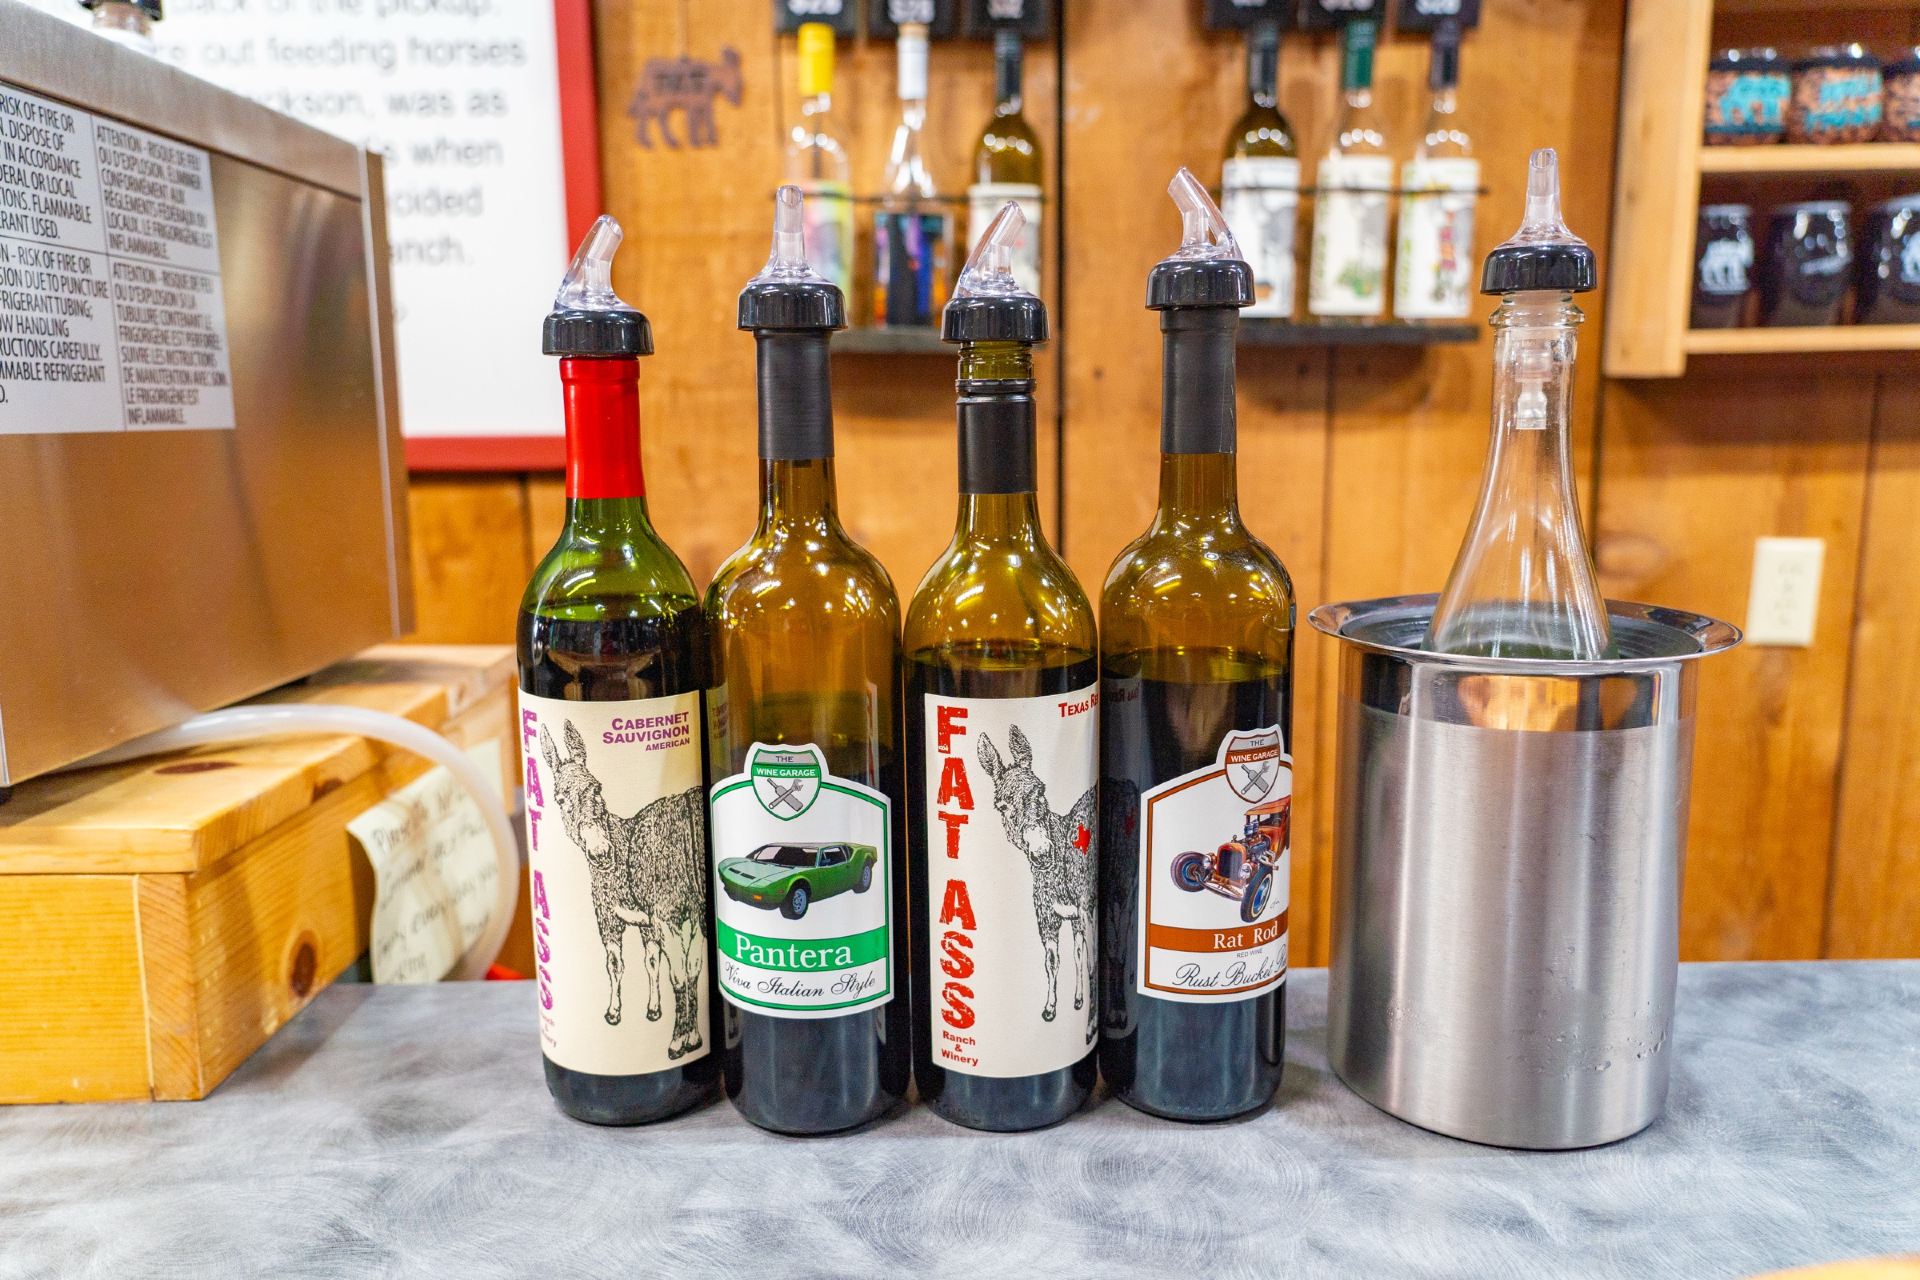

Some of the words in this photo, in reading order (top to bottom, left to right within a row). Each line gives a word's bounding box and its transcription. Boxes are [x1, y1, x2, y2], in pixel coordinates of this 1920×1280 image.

[407, 37, 527, 66] horses
[466, 91, 507, 116] as
[39, 106, 60, 130] FIRE
[61, 114, 75, 133] OR
[10, 120, 51, 149] DISPOSE
[53, 133, 65, 151] OF
[4, 142, 16, 162] IN
[19, 145, 82, 180] ACCORDANCE
[31, 172, 46, 192] OR
[46, 175, 77, 199] LOCAL
[32, 194, 93, 224] FLAMMABLE
[31, 219, 61, 240] USED.
[18, 246, 42, 268] RISK
[42, 250, 55, 270] OF
[58, 253, 78, 273] FIRE
[78, 256, 92, 274] OR
[25, 270, 46, 291] DUE
[46, 274, 59, 292] TO
[61, 275, 109, 299] PUNCTURE
[17, 315, 70, 337] HANDLING
[50, 340, 102, 361] CAREFULLY.
[44, 362, 105, 383] REFRIGERANT
[1058, 700, 1089, 718] TEXAS
[611, 711, 689, 731] CABERNET
[602, 725, 690, 744] SAUVIGNON
[646, 738, 690, 751] AMERICAN
[1249, 739, 1265, 747] THE
[775, 755, 794, 763] THE
[1231, 754, 1252, 763] WINE
[1253, 749, 1279, 760] GARAGE
[757, 767, 779, 776] WINE
[780, 769, 816, 777] GARAGE
[937, 705, 975, 859] FAT
[523, 708, 544, 852] FAT
[534, 869, 554, 1011] ASS
[1213, 933, 1244, 949] Rat
[1253, 921, 1279, 944] Rod
[734, 933, 854, 969] Pantera
[939, 878, 977, 1029] ASS
[1249, 948, 1264, 957] WINE
[725, 961, 751, 989] Viva
[757, 976, 825, 998] Italian
[831, 970, 876, 999] Style
[1172, 963, 1220, 987] Rust
[1221, 956, 1274, 987] Bucket
[942, 1030, 976, 1046] Ranch
[954, 1043, 963, 1053] &
[941, 1047, 979, 1067] Winery
